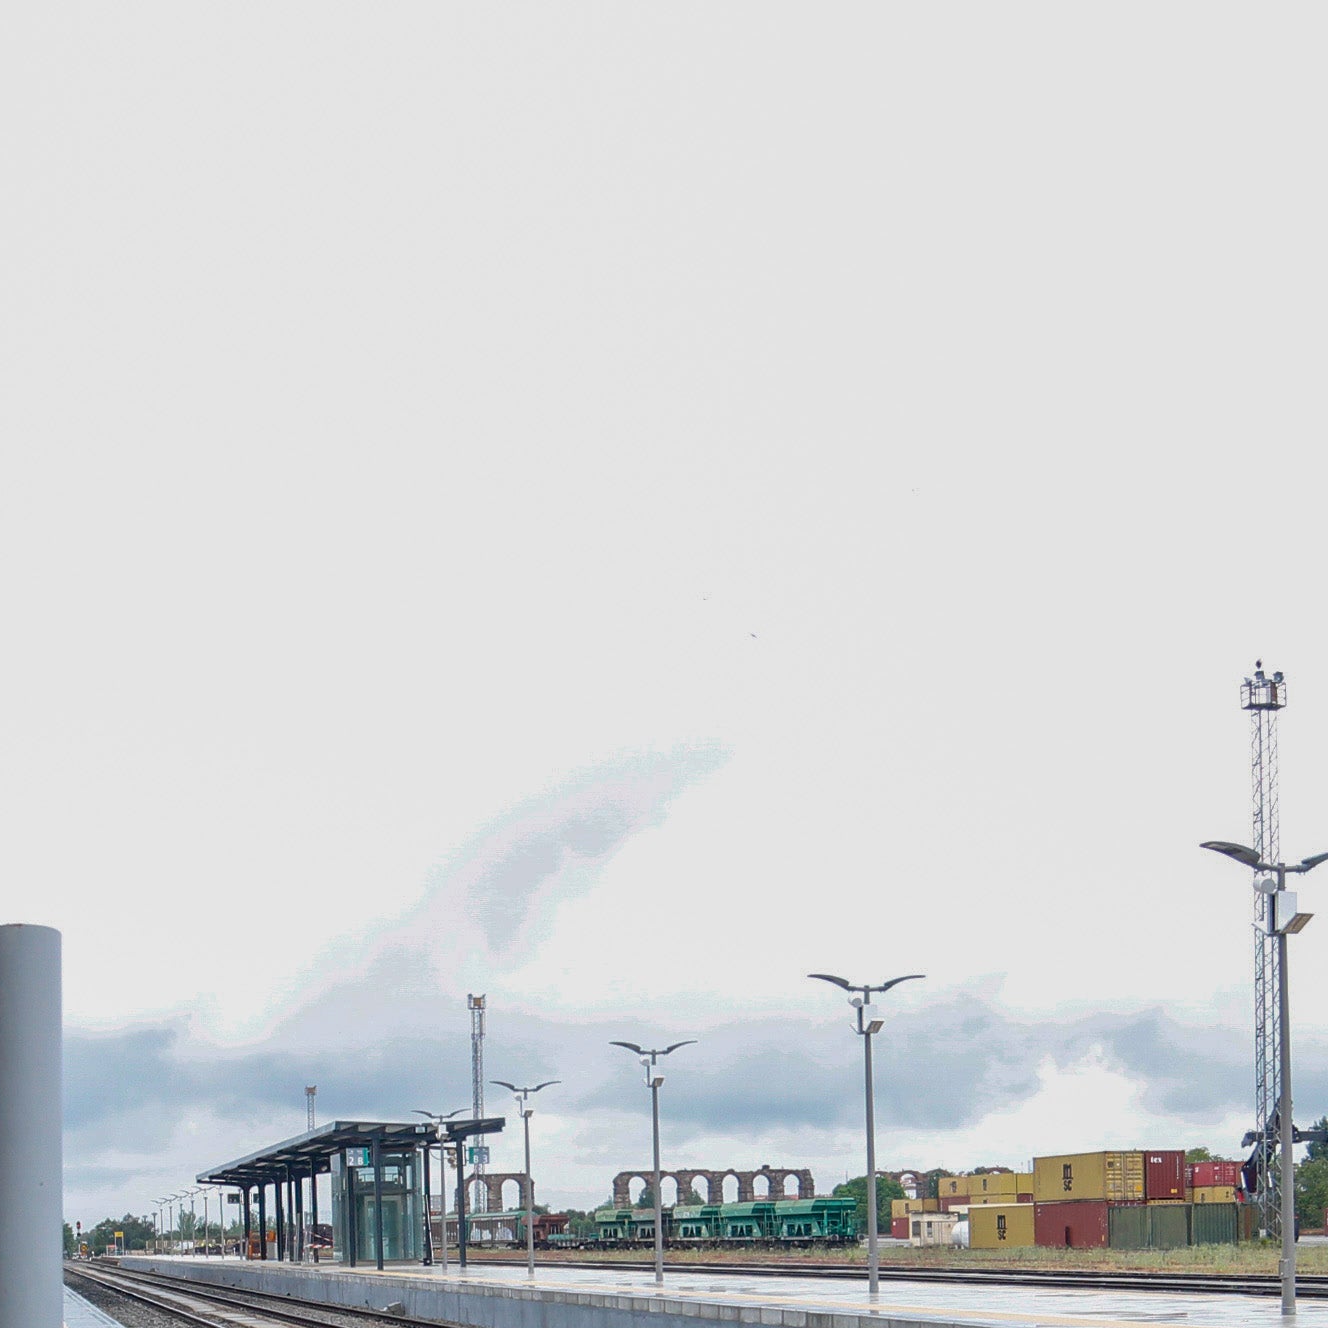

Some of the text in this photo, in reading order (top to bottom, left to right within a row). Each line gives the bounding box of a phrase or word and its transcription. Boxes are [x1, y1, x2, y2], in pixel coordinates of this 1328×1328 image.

[348, 1156, 364, 1166] 2 B
[482, 1154, 488, 1164] 3
